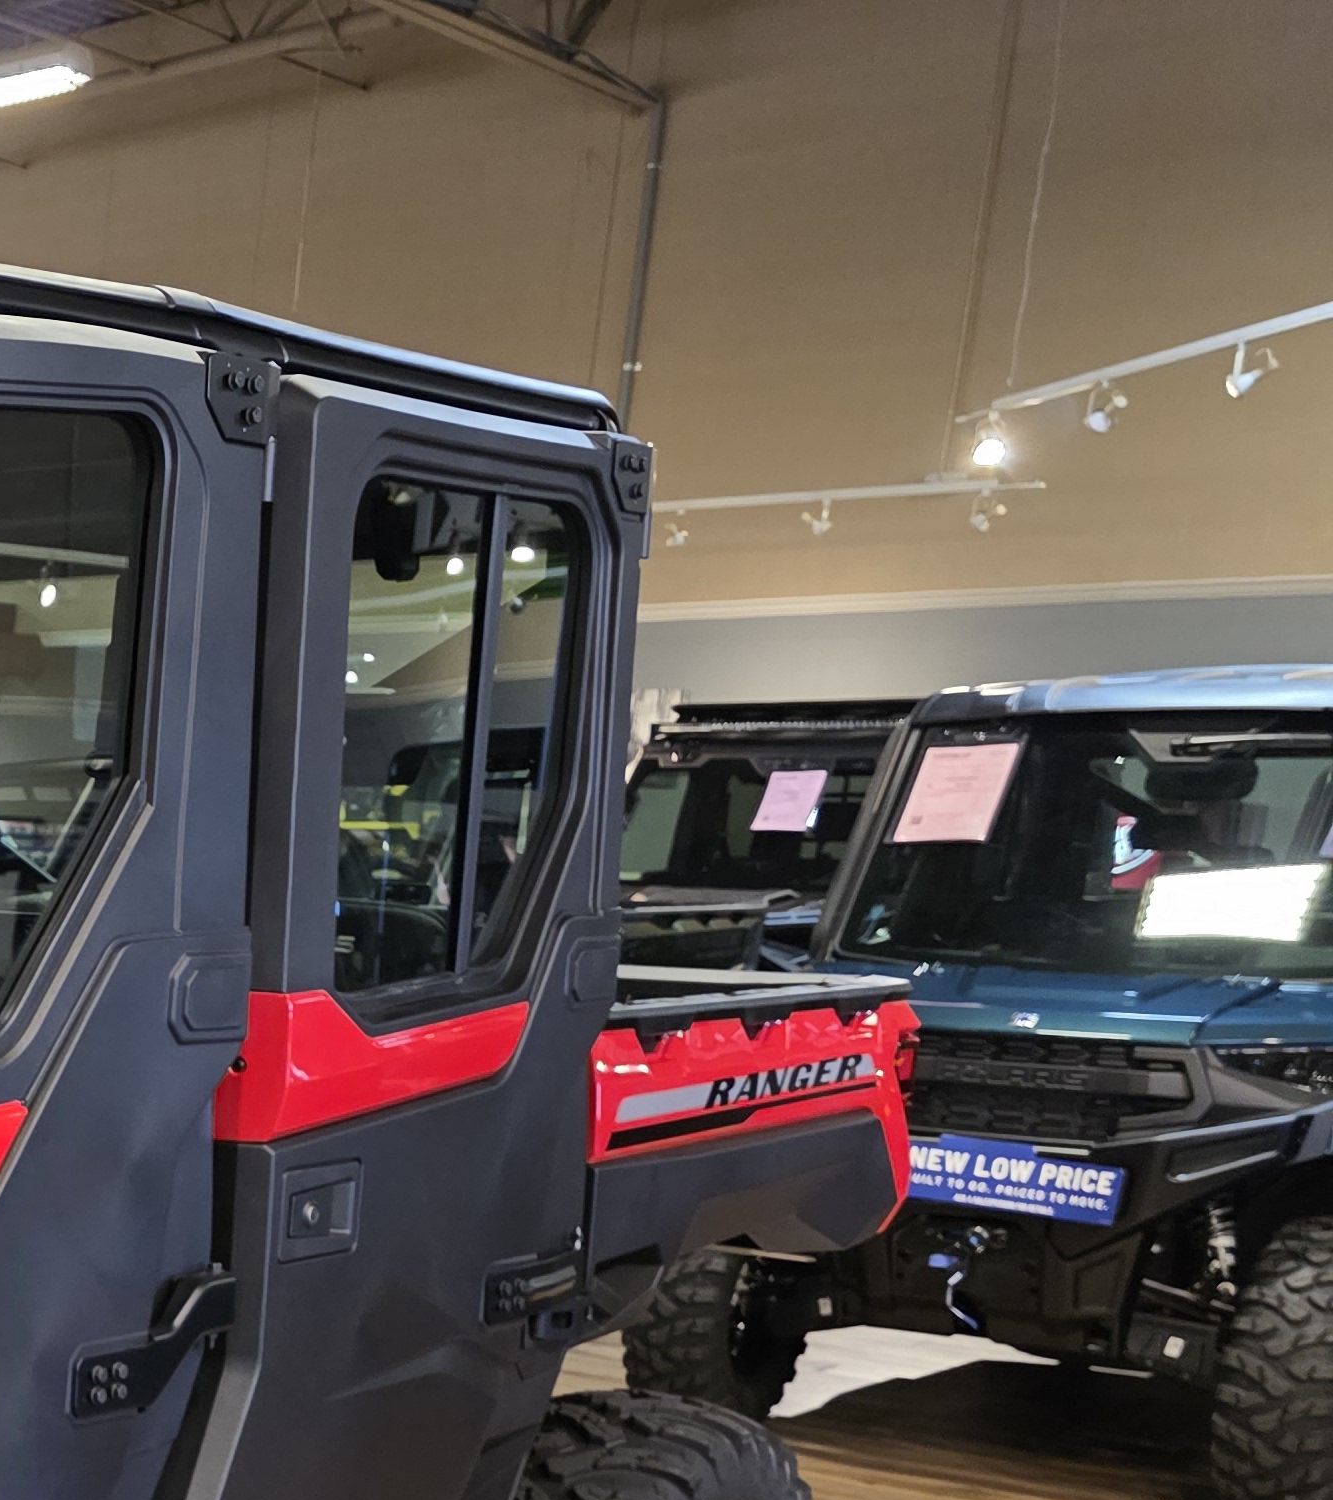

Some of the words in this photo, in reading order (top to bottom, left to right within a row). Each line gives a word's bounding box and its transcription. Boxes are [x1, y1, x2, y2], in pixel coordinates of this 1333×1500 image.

[704, 1052, 864, 1109] RANGER
[909, 1145, 971, 1175] NEW
[973, 1153, 1037, 1184] LOW
[1038, 1161, 1119, 1197] PRICE
[910, 1171, 945, 1188] UILT
[946, 1176, 966, 1190] TO
[994, 1183, 1047, 1201] PRICED
[1049, 1190, 1067, 1204] TO
